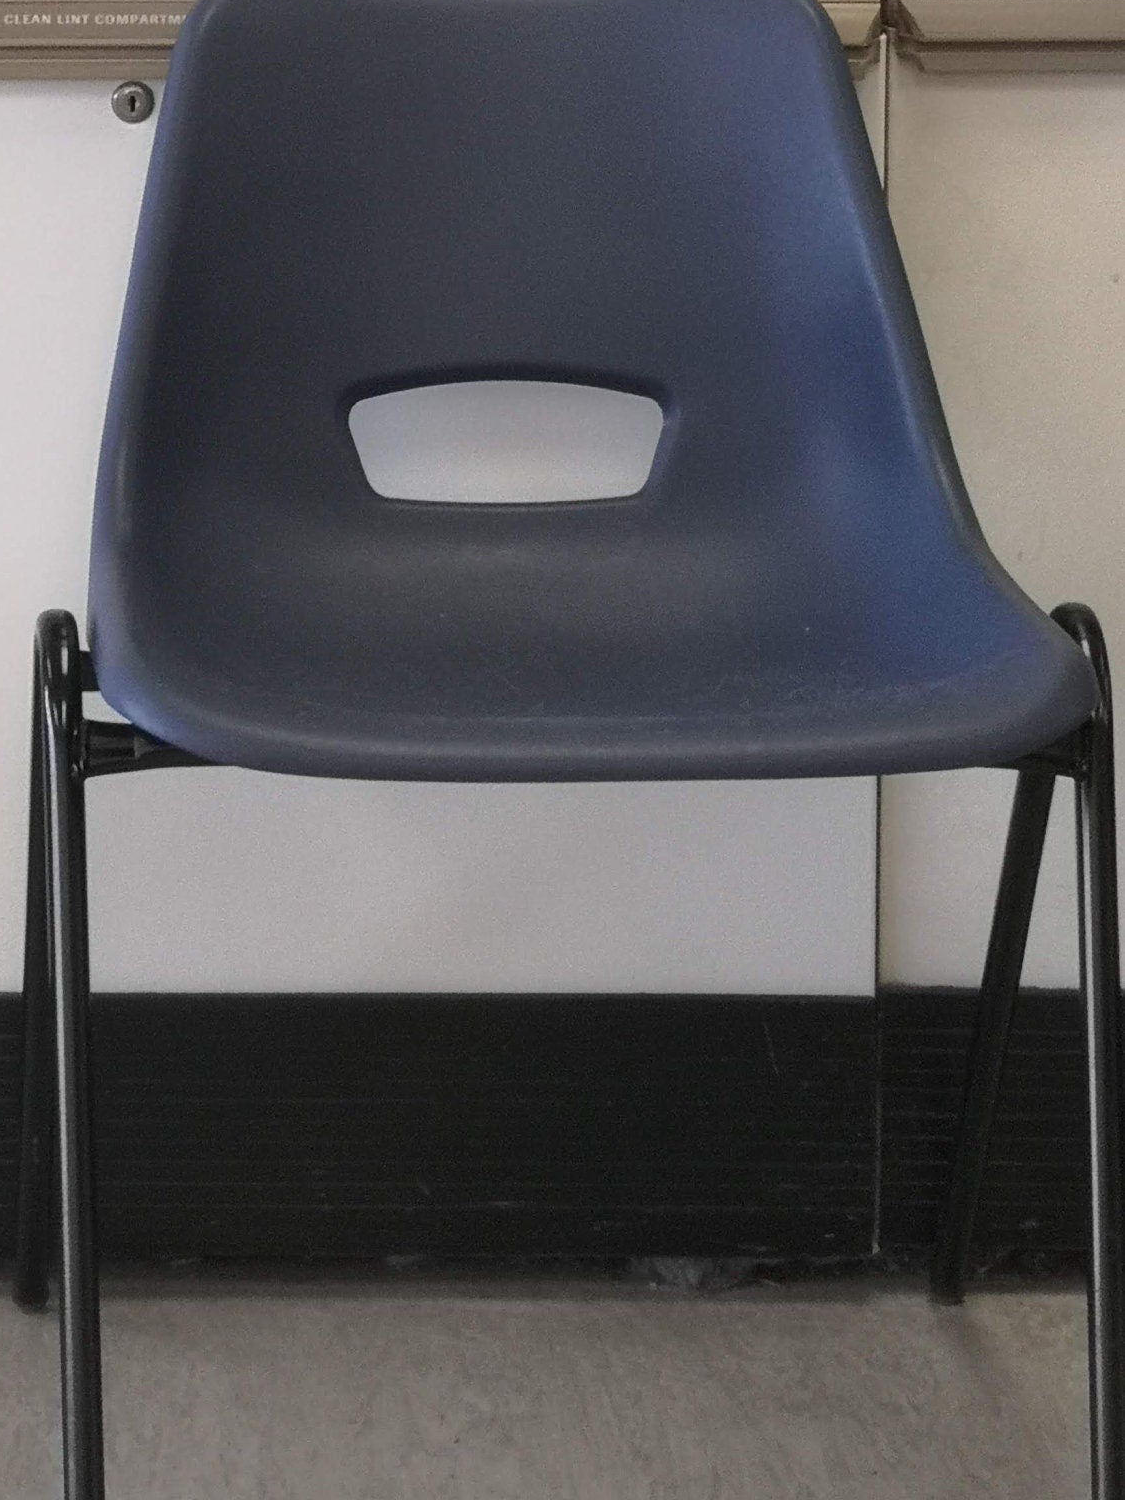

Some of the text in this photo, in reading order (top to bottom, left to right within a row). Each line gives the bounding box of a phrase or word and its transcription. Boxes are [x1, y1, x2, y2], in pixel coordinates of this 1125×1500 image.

[3, 13, 186, 25] CLEAN LINT COMPARTM
